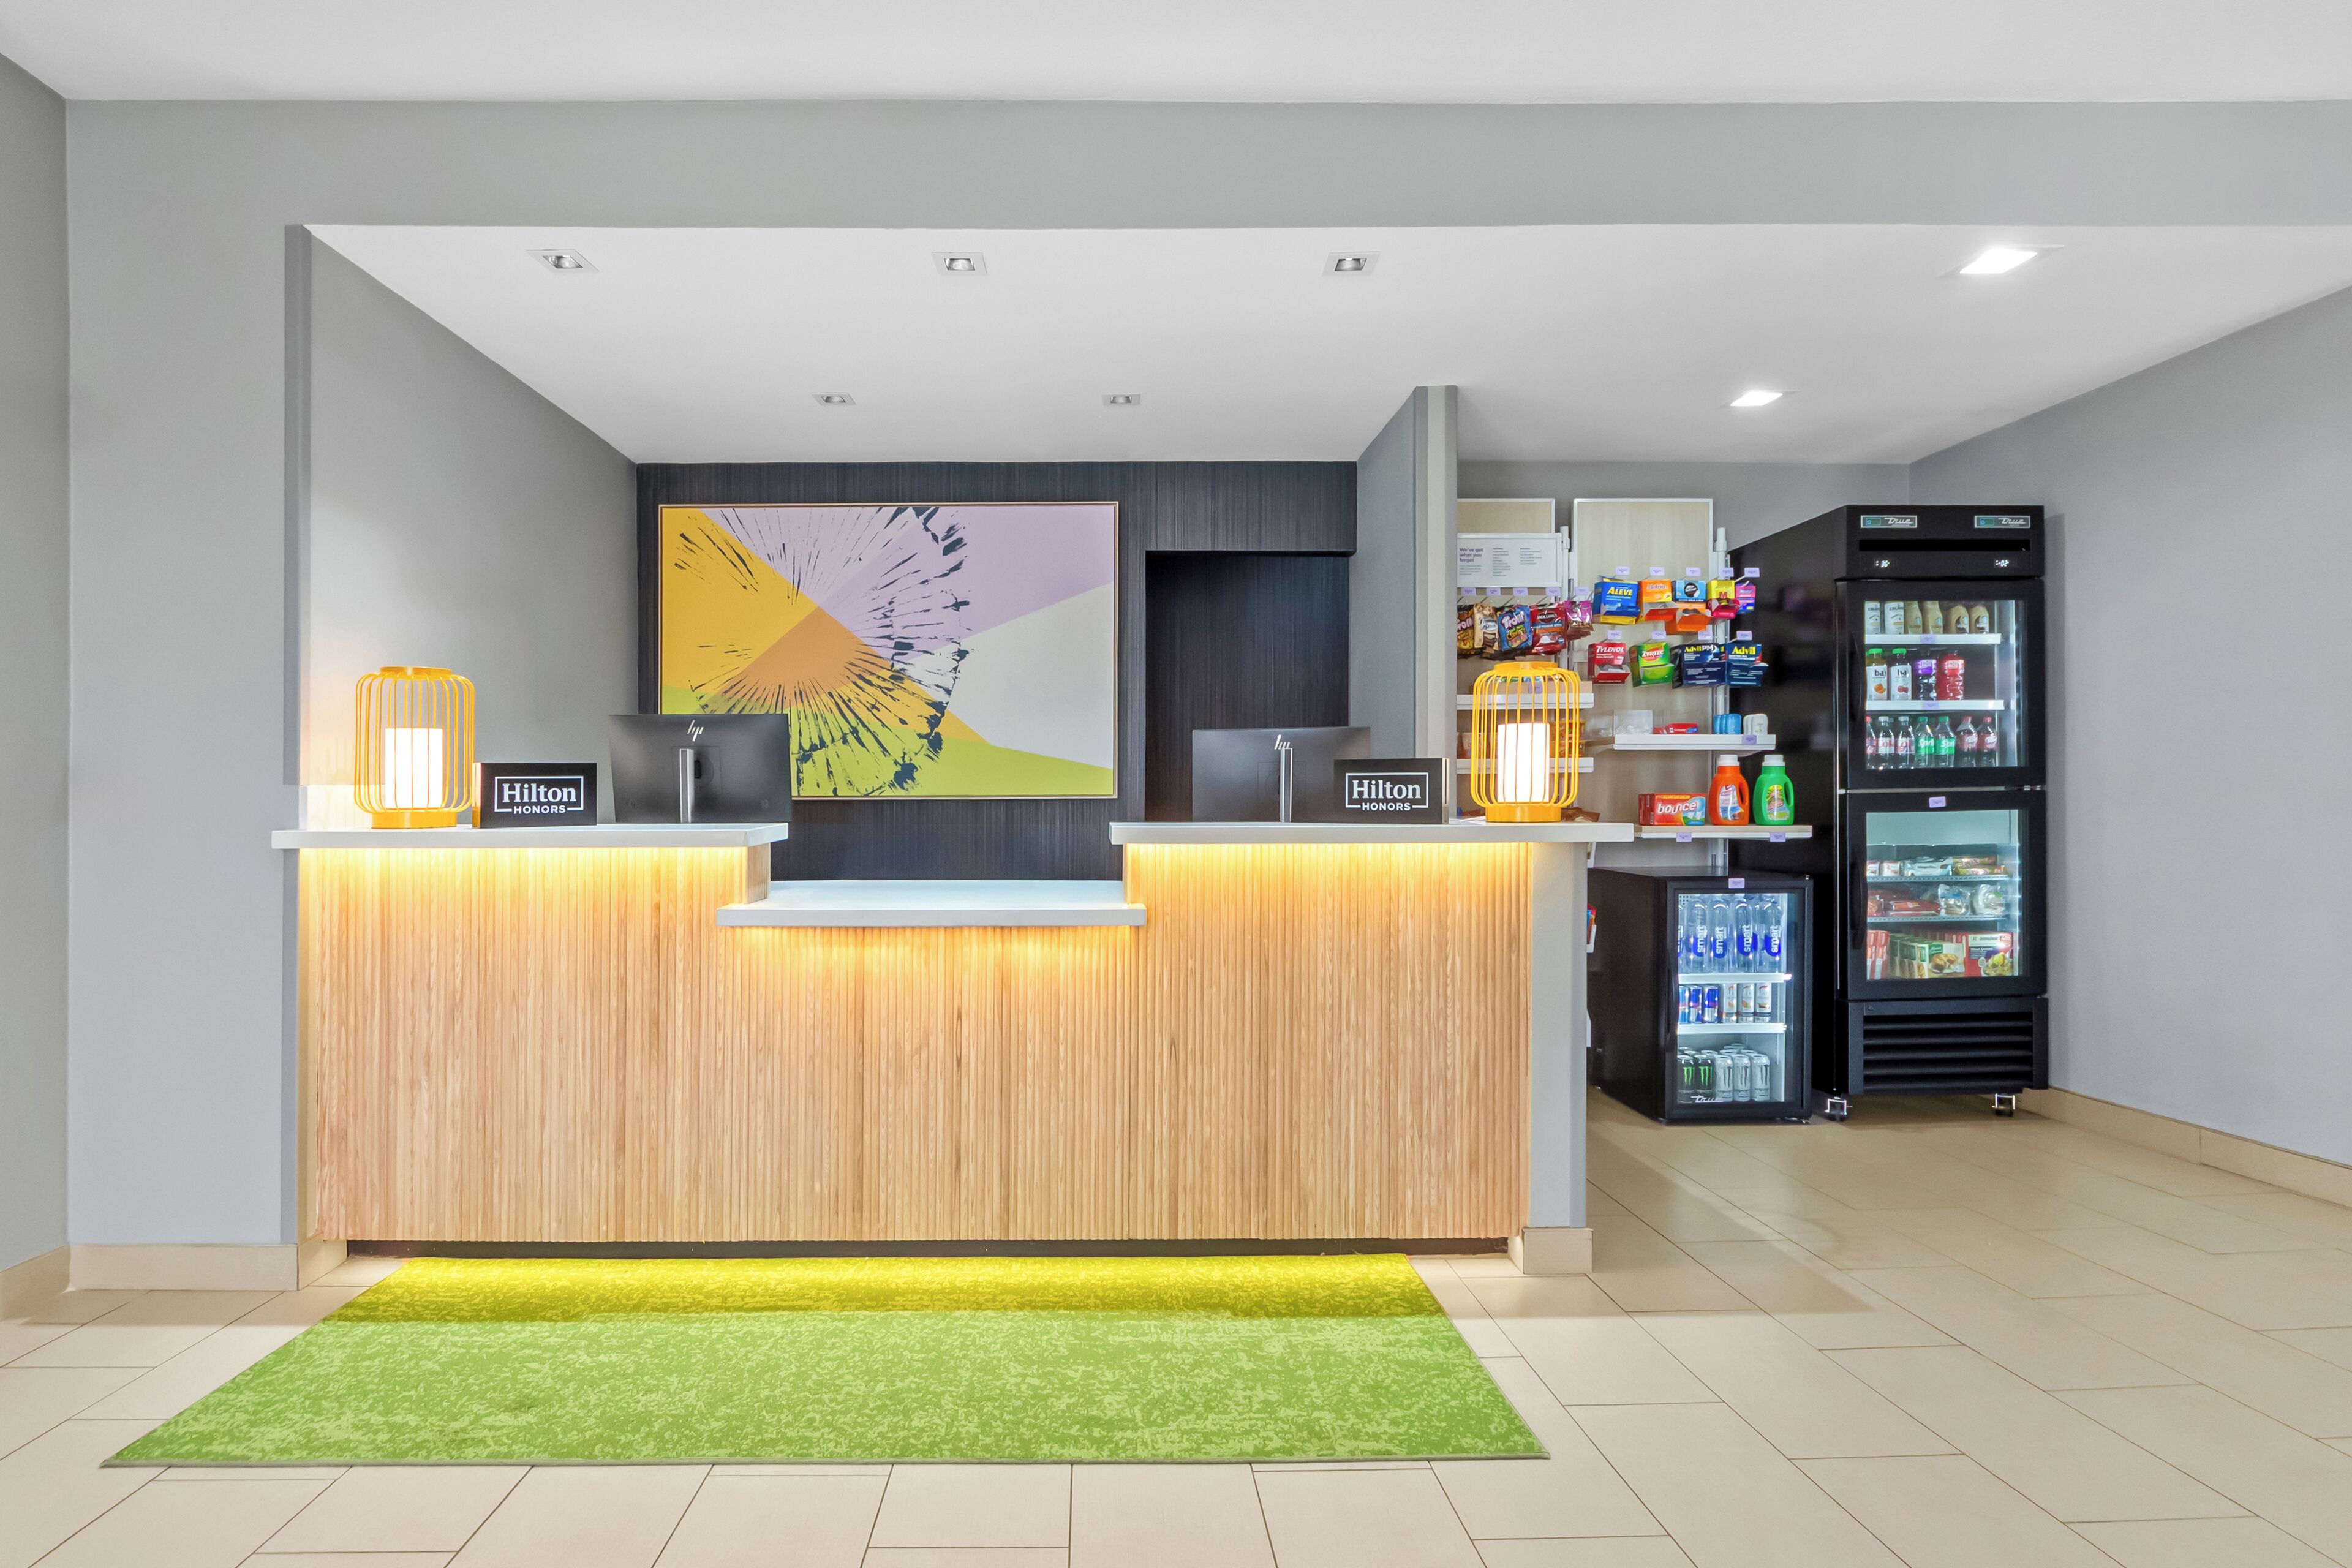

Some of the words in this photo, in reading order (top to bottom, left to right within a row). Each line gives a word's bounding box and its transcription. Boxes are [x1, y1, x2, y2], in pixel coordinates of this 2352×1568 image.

[1607, 586, 1633, 596] ALEVE
[1732, 646, 1756, 655] Advil
[687, 720, 704, 742] hp
[502, 783, 577, 802] Hilton
[1352, 780, 1421, 799] Hilton
[513, 805, 566, 815] HONORS
[1362, 802, 1411, 811] HONORS
[1657, 801, 1697, 814] bounce
[1715, 927, 1724, 954] smart
[1742, 925, 1752, 952] smart
[1770, 925, 1779, 953] smart
